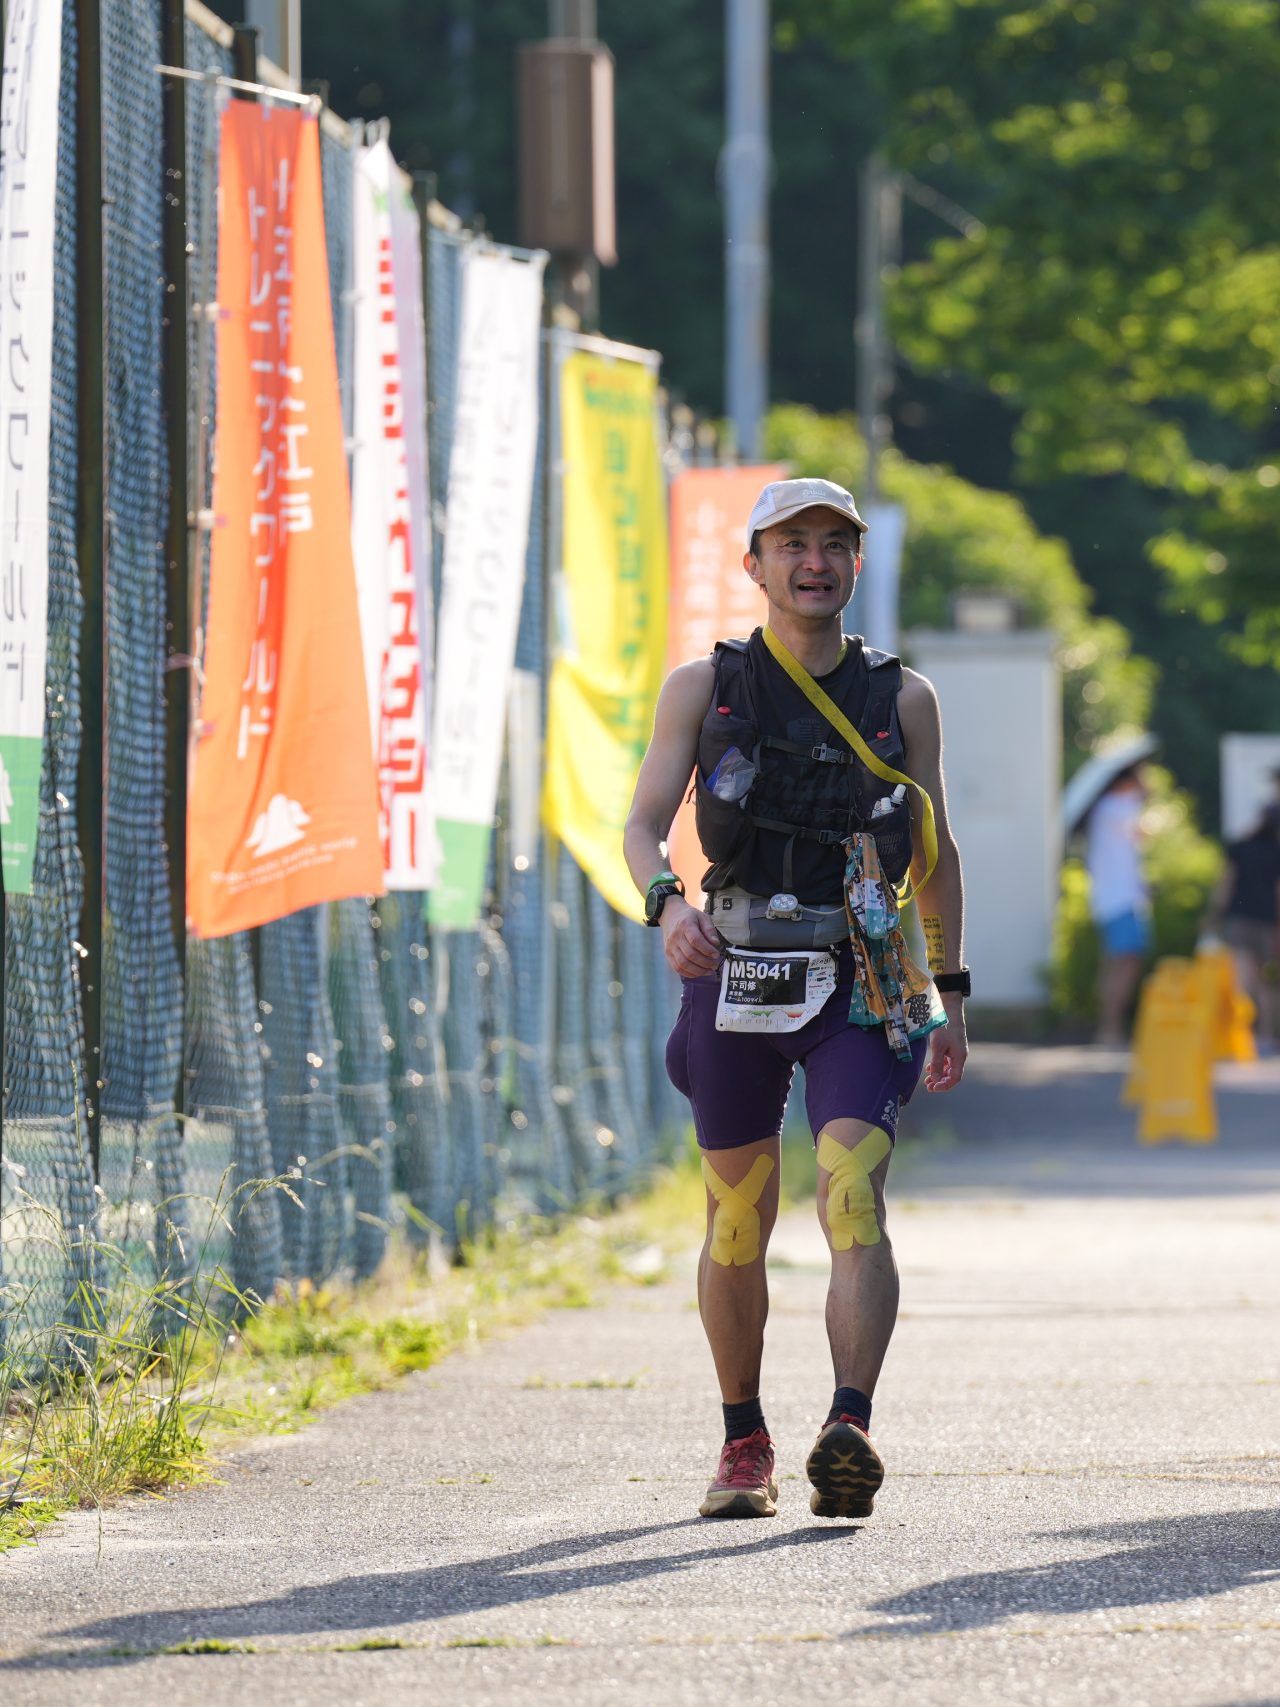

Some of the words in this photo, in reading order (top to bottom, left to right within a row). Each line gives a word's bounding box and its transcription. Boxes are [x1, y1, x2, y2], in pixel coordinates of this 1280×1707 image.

[730, 960, 791, 981] M5041
[729, 980, 757, 991] 下司修
